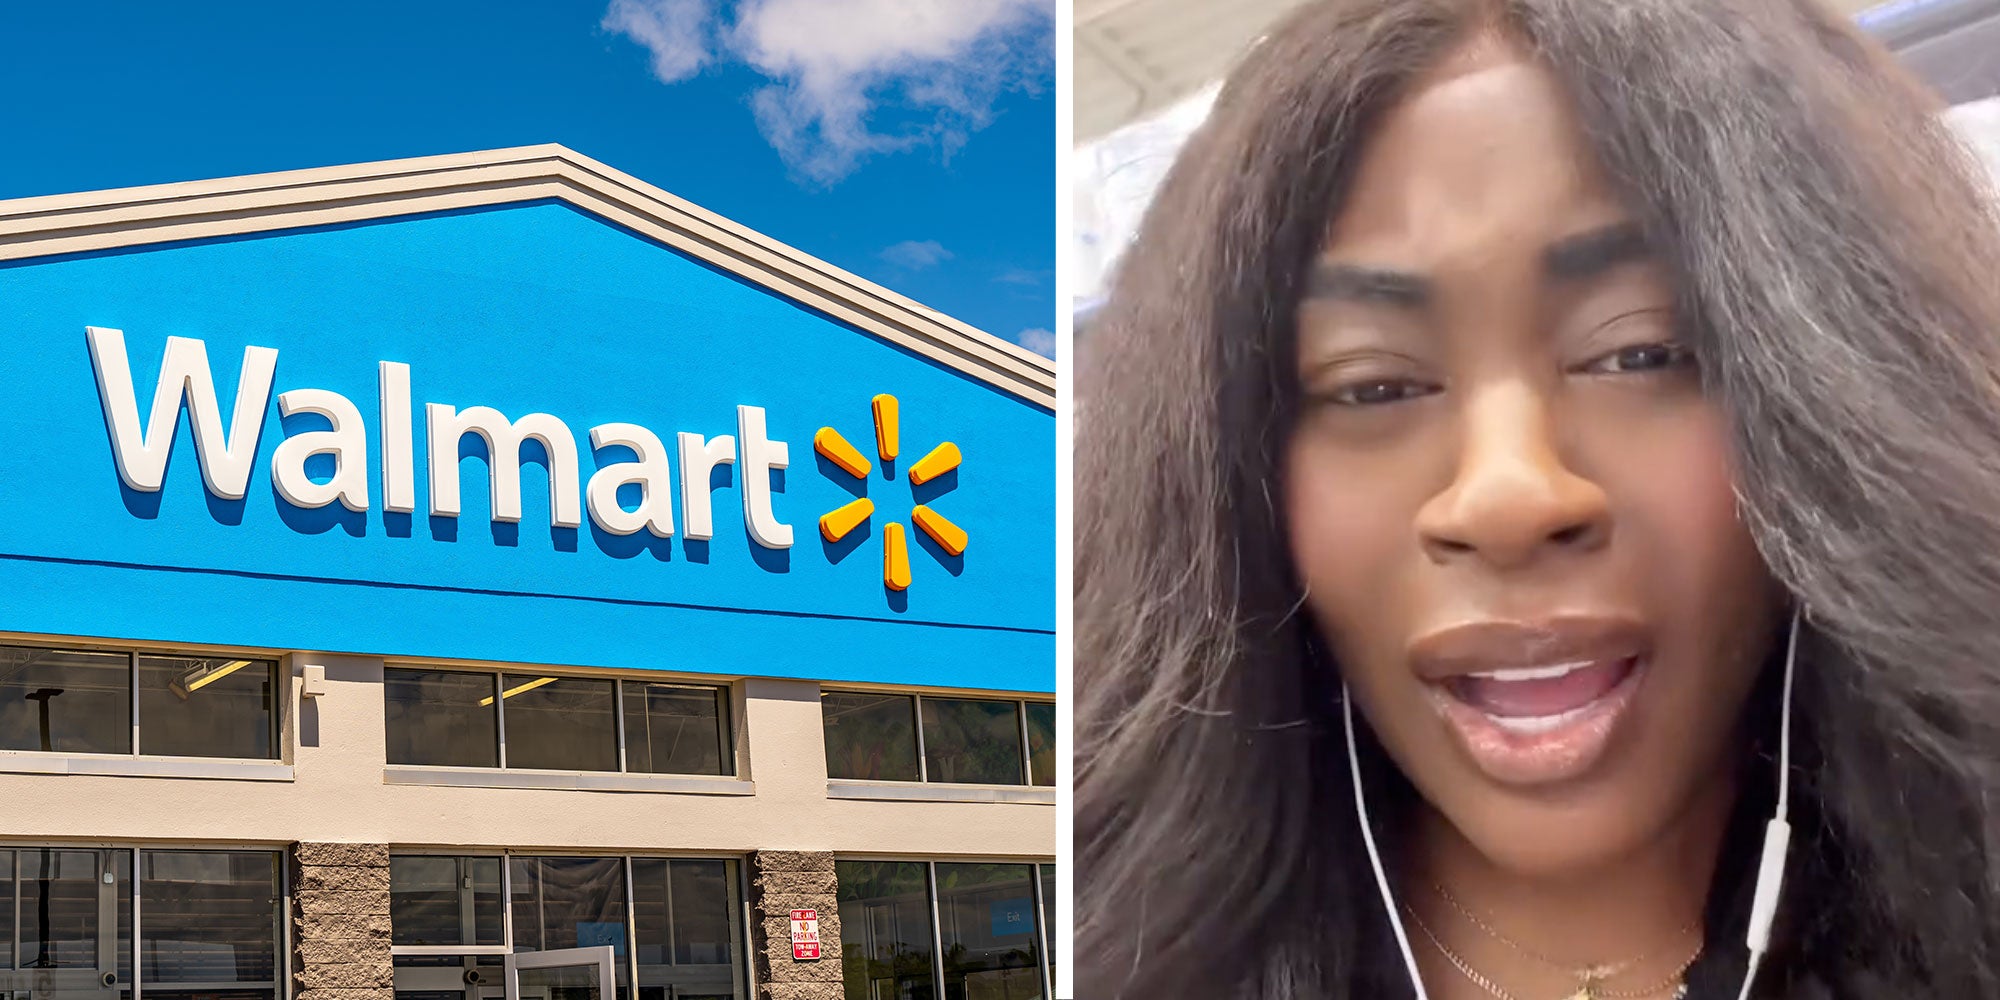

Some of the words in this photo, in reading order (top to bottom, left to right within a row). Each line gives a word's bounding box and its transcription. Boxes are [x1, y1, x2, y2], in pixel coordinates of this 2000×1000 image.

[85, 326, 793, 549] Walmart
[792, 911, 802, 919] FIRE
[803, 911, 815, 919] LANE
[1007, 911, 1021, 922] Exit
[799, 922, 810, 931] NO
[793, 931, 818, 941] PARKING
